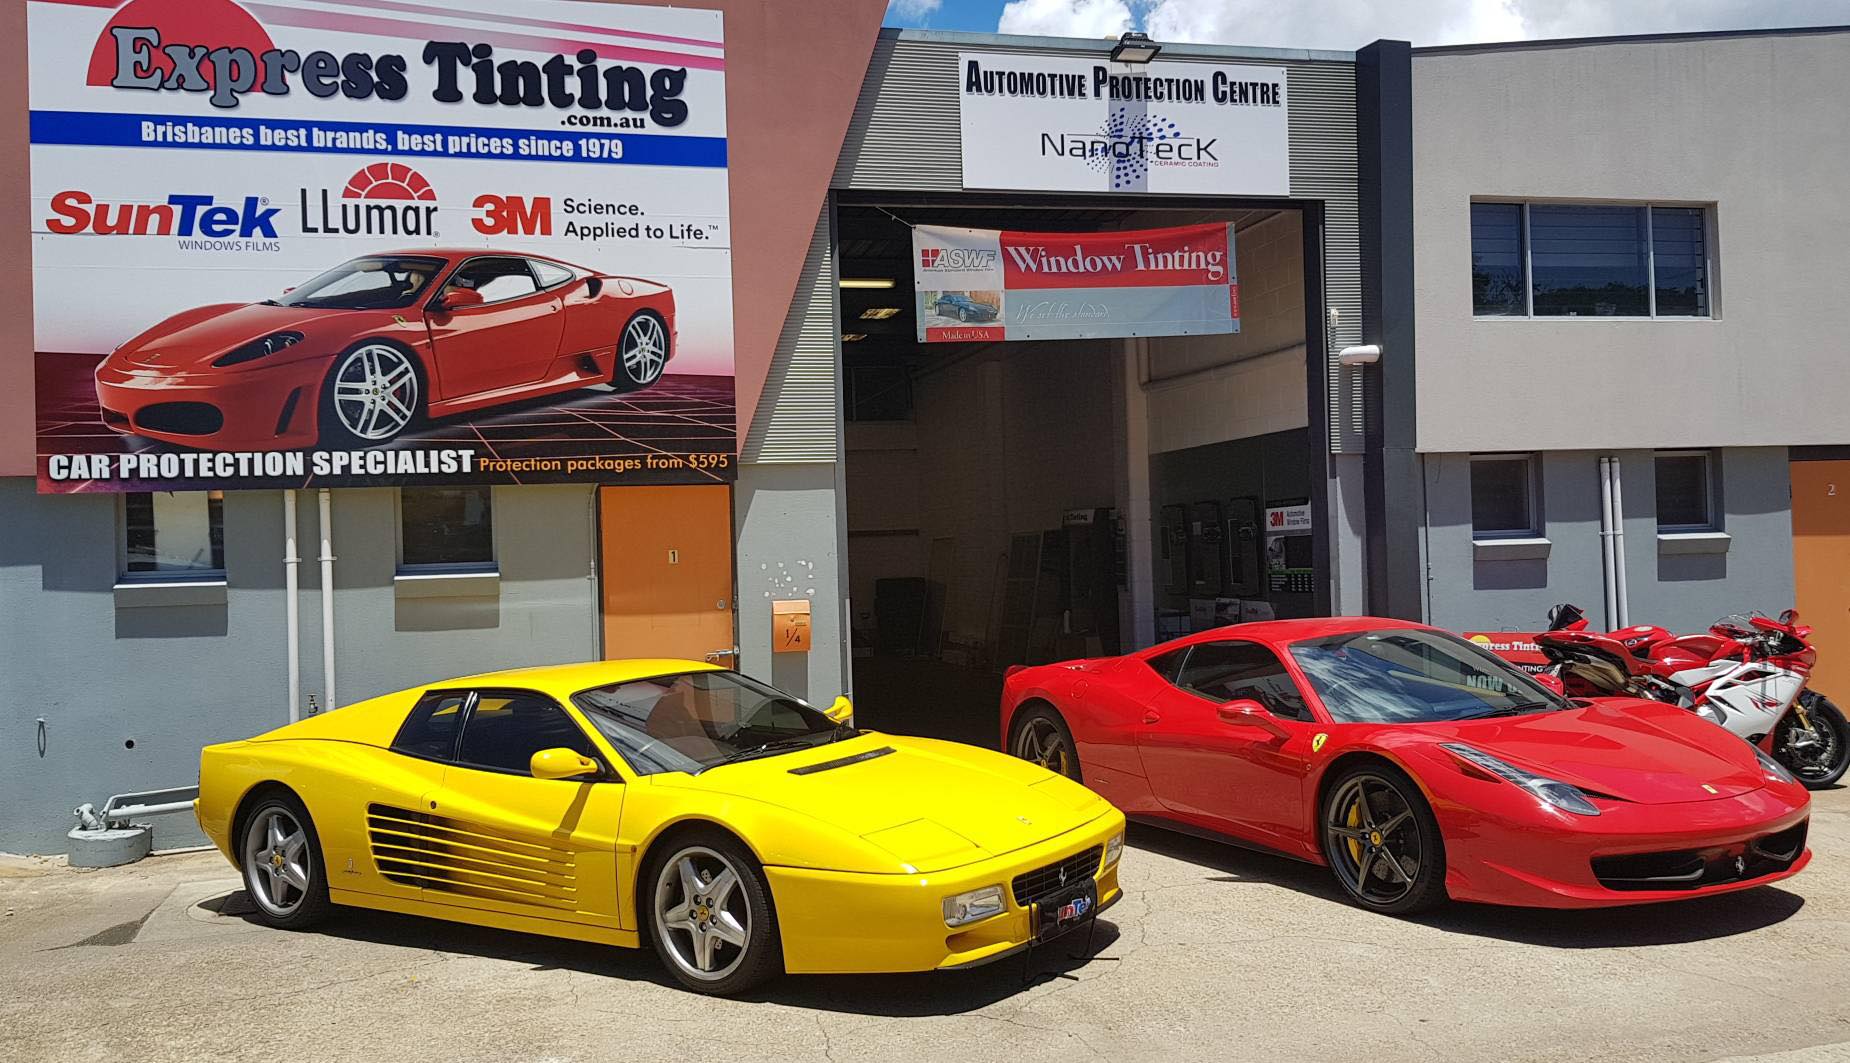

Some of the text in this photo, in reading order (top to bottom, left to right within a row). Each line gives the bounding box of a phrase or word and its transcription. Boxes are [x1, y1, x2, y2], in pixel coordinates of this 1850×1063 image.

[110, 26, 688, 127] Express Tinting
[965, 60, 1280, 105] AUTOMOTIVE PROTECTION CENTRE
[560, 110, 646, 130] .com.au
[141, 120, 624, 159] Brisbanes best brands, best prices since 1979
[45, 190, 282, 240] SunTek
[471, 195, 552, 236] 3M
[563, 198, 645, 217] Science.
[563, 221, 640, 241] Applied
[645, 224, 665, 239] to
[178, 240, 281, 251] WINDOWS FILMS
[933, 248, 996, 268] ASWF
[1005, 243, 1223, 281] Window Tinting
[942, 331, 963, 339] Made
[973, 330, 990, 339] USA
[49, 449, 474, 479] CAR PROTECTION SPECIALIST
[480, 454, 728, 474] Protection packages from $595
[1827, 483, 1836, 496] 2
[1270, 511, 1284, 527] 3M
[1480, 643, 1510, 651] press
